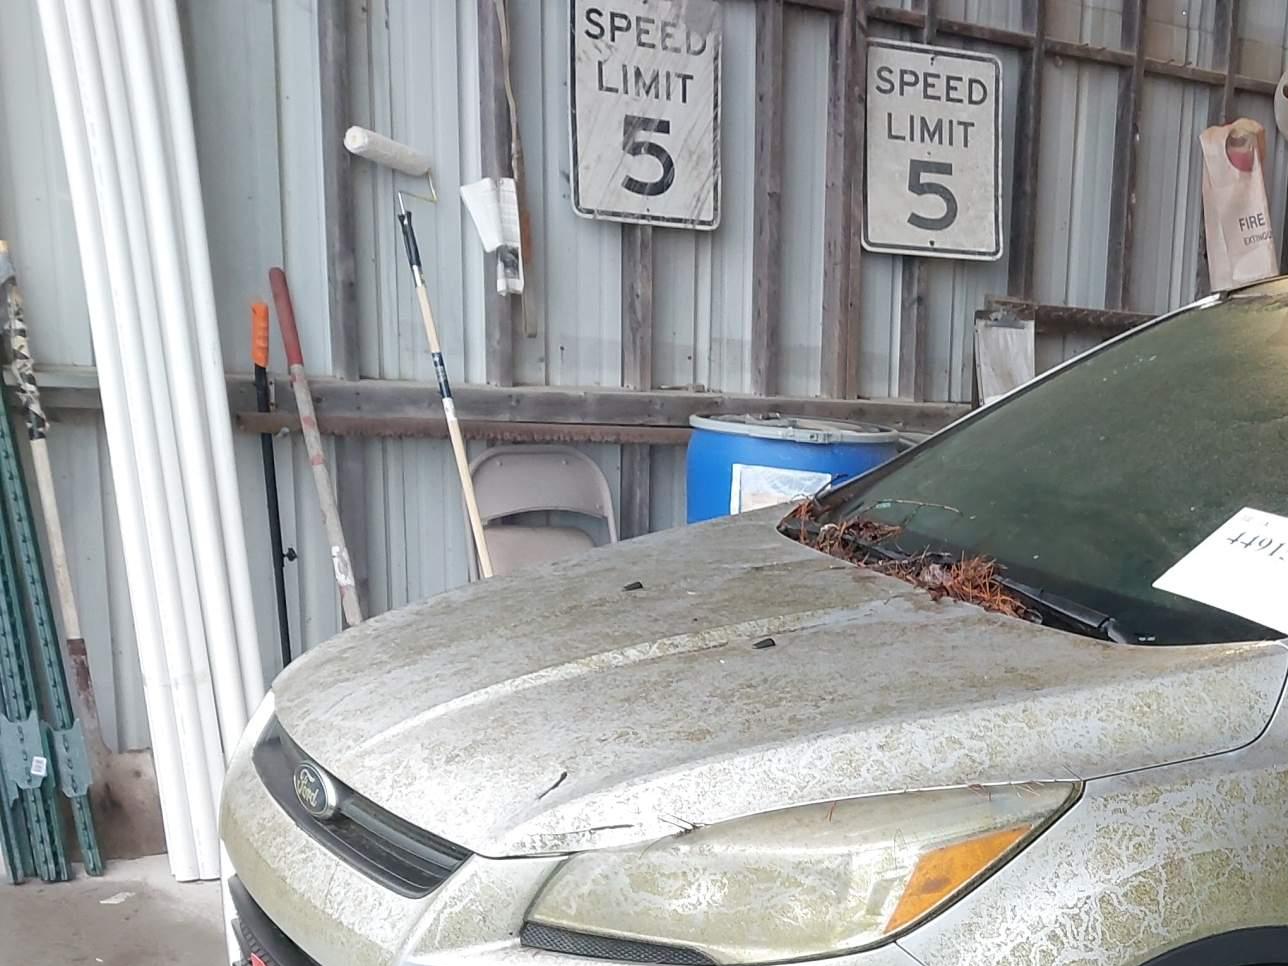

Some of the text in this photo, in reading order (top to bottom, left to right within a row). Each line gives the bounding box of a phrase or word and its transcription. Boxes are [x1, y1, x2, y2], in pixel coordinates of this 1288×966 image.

[585, 8, 707, 57] SPEED
[597, 60, 694, 104] LIMIT
[875, 65, 988, 106] SPEED
[886, 112, 976, 149] LIMIT
[621, 114, 676, 197] 5
[906, 158, 959, 232] 5
[1239, 212, 1266, 232] FIRE
[296, 768, 320, 808] Ford
